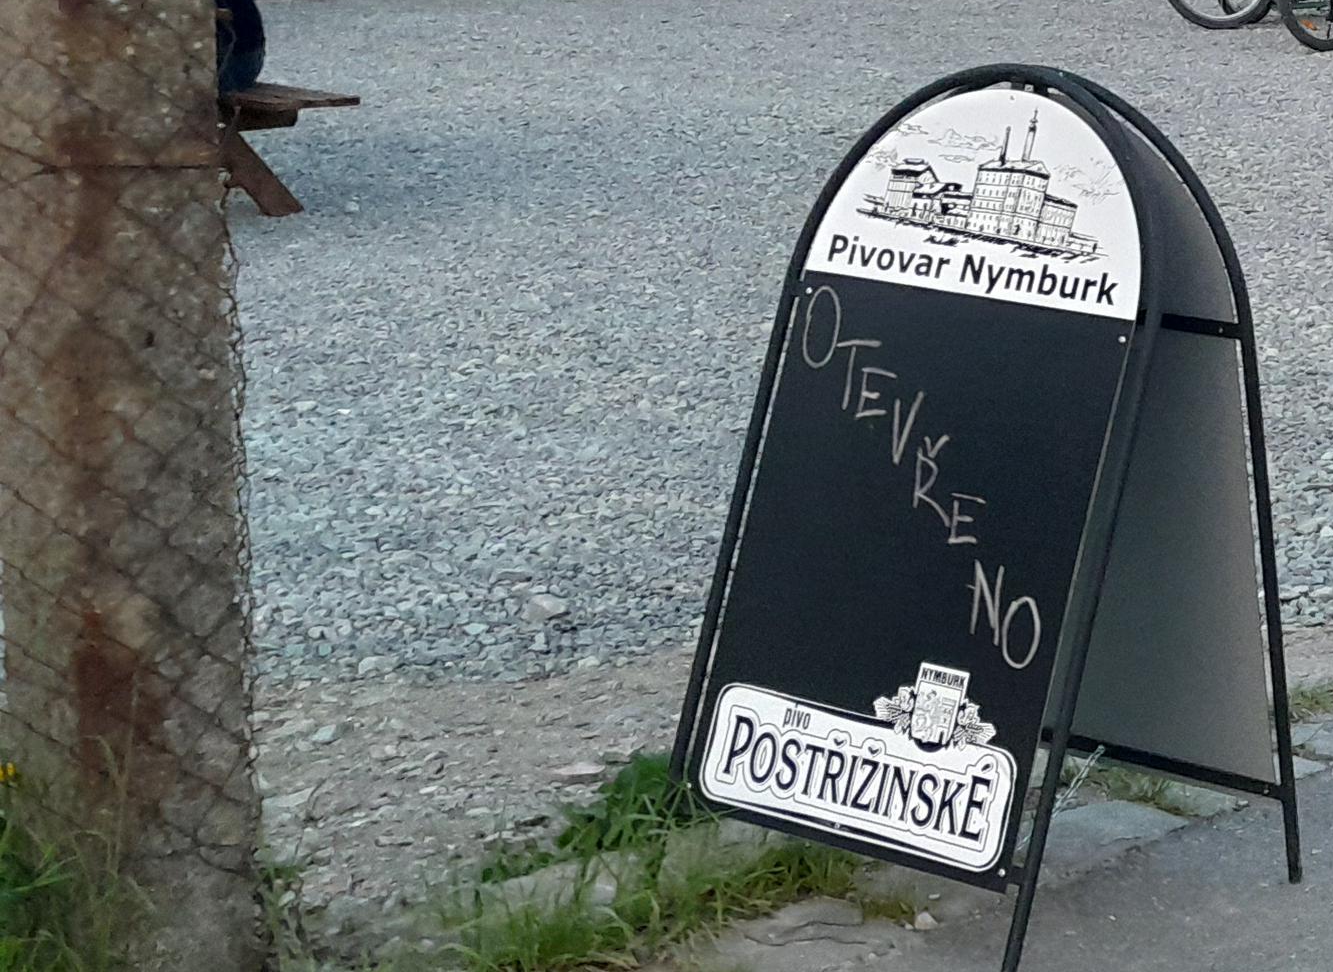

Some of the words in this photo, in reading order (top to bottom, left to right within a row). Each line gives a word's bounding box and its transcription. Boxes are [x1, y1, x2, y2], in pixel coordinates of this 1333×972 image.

[827, 233, 953, 280] Pivovar
[959, 253, 1120, 307] Nymburk
[920, 666, 967, 689] NYMBURK
[721, 714, 994, 843] POSTŘIŽINSKÉ
